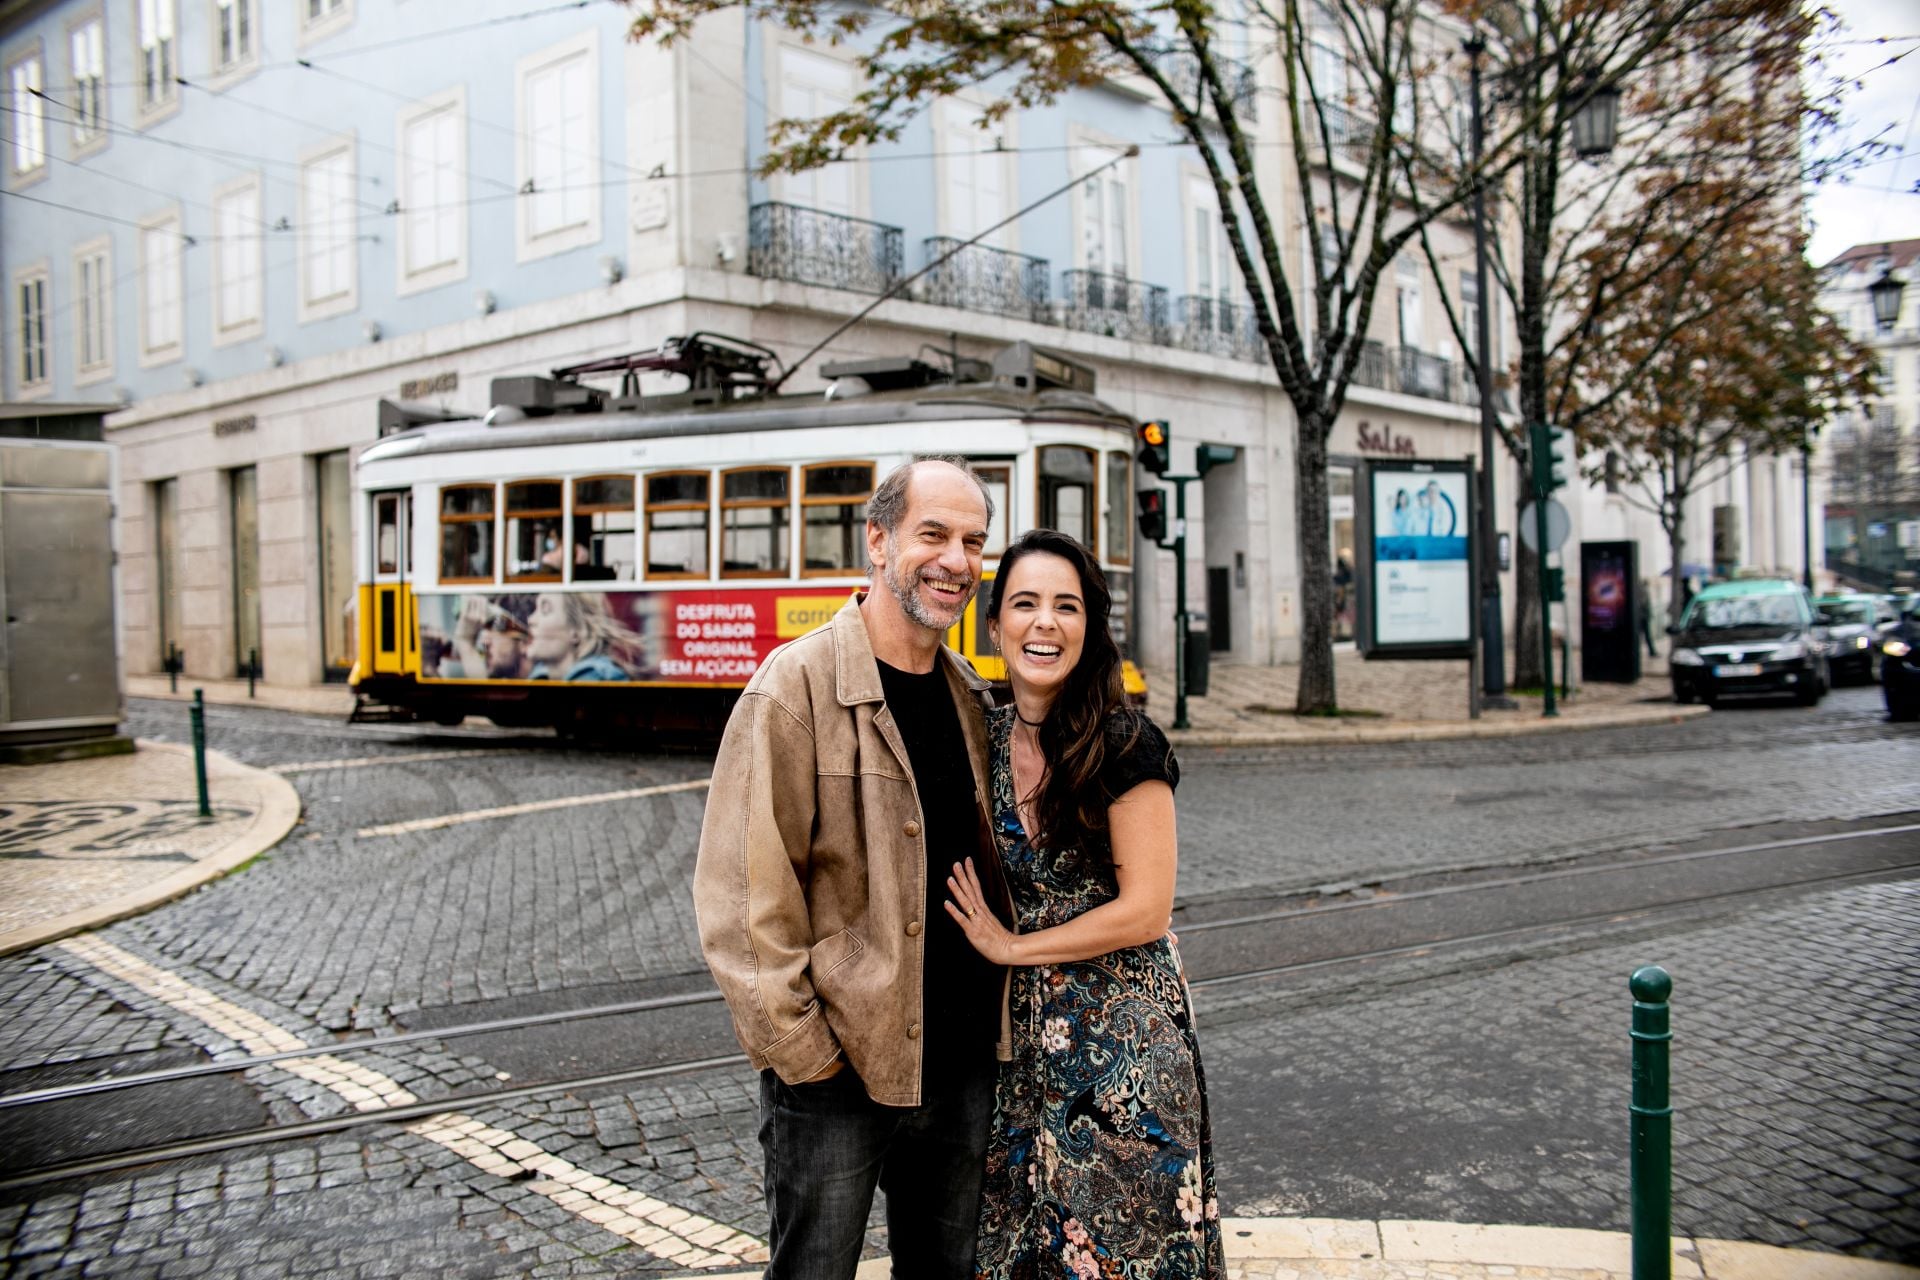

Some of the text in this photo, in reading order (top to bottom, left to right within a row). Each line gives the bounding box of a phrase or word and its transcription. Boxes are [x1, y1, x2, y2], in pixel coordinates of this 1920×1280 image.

[1357, 420, 1416, 456] Salsa
[676, 603, 756, 620] DESFRUTA
[676, 622, 756, 639] DO SABOR
[683, 641, 758, 657] ORIGINAL
[660, 656, 758, 679] SEM AÇÚCAR
